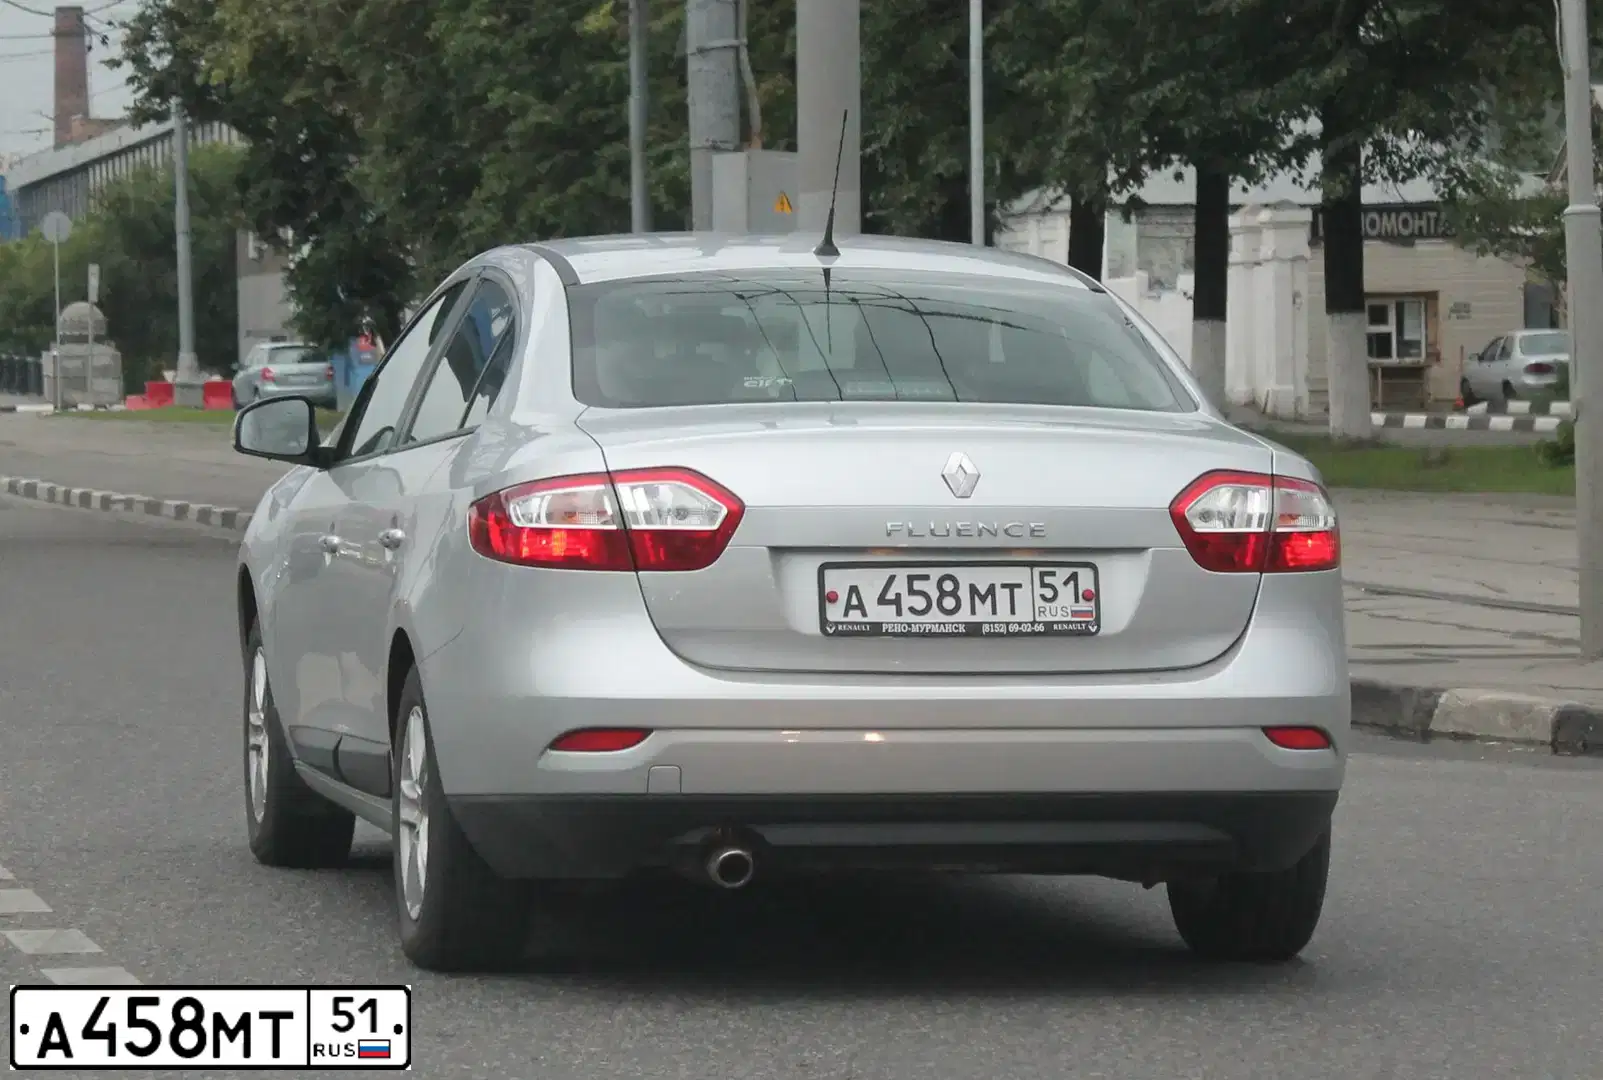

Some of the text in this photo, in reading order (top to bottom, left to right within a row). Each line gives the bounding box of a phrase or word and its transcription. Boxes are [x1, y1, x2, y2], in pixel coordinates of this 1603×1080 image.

[886, 520, 1047, 538] FLUENCE
[1038, 570, 1080, 604] 51
[1038, 606, 1069, 618] RUS
[838, 623, 1086, 635] RENAULT РЕНО-МУРМАНСК (8152) 69-02-66 RENAULT
